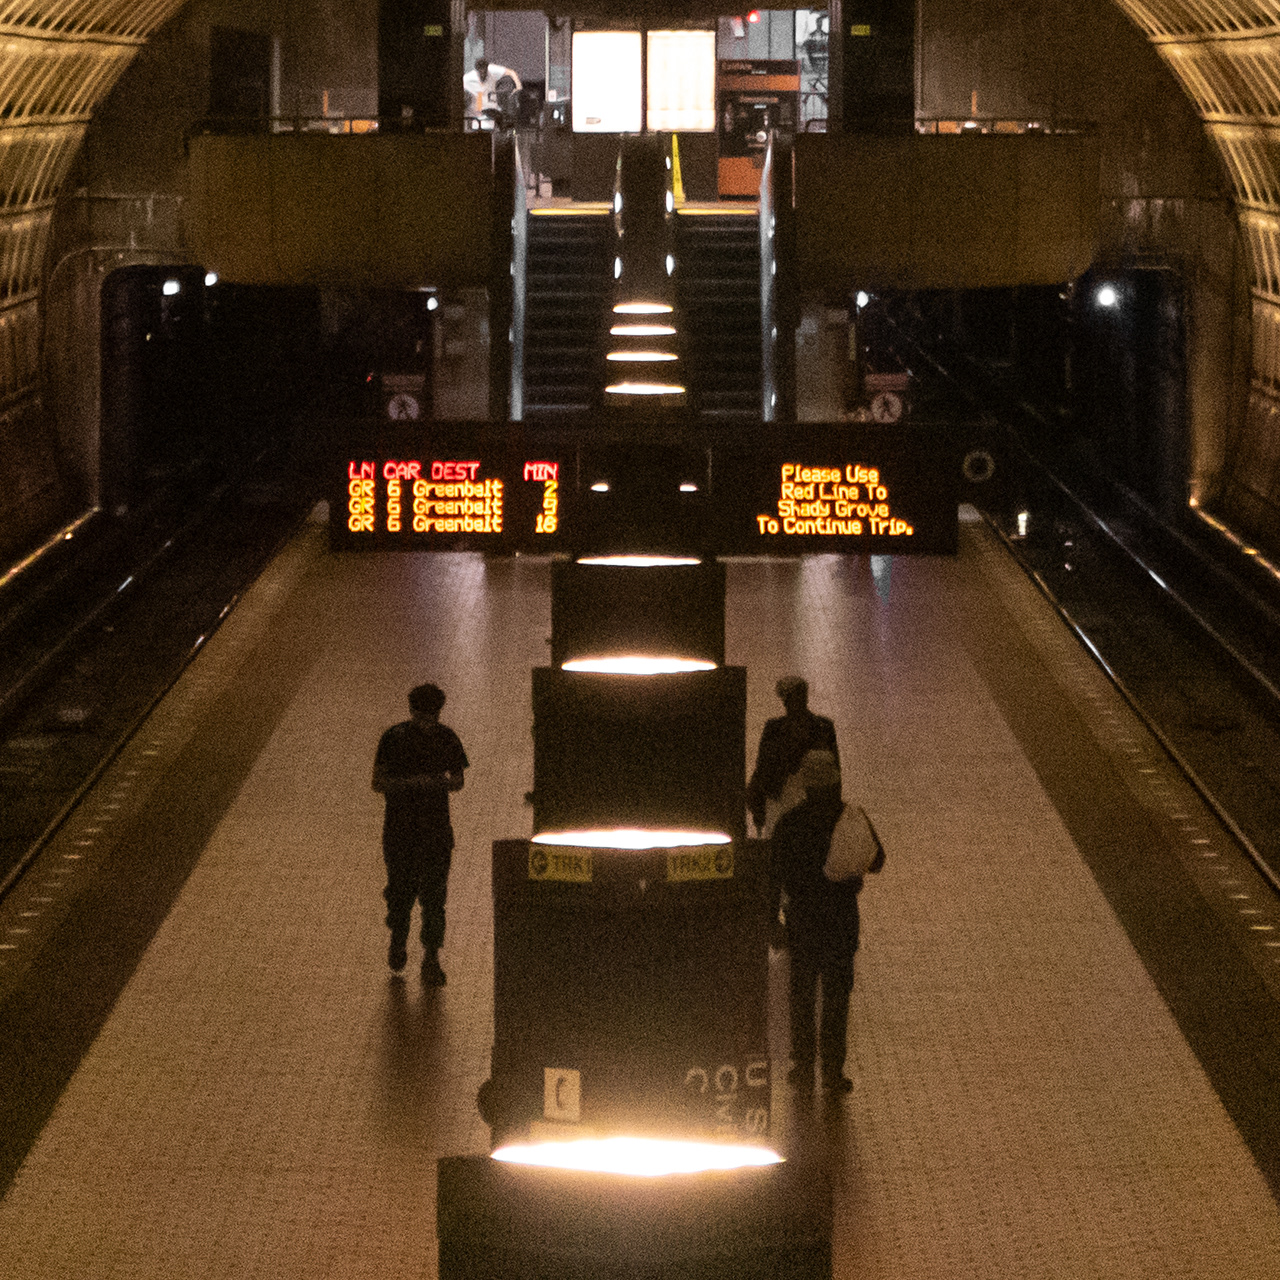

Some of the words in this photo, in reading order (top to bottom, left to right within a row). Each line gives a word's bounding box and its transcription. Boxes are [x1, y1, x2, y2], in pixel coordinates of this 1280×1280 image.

[348, 461, 376, 479] LN
[383, 460, 421, 480] CAR
[431, 461, 480, 480] DEST
[523, 461, 559, 481] MIN
[781, 464, 842, 483] Please
[845, 464, 880, 483] Use
[348, 479, 376, 497] GR
[386, 479, 401, 497] 6
[413, 479, 504, 497] Greenbelt
[543, 480, 559, 497] 2
[781, 483, 815, 500] Red
[819, 483, 859, 500] Line
[865, 483, 888, 500] To
[348, 497, 376, 514] GR
[386, 497, 402, 514] 6
[413, 497, 504, 514] Greenbelt
[542, 497, 559, 515] 9
[778, 500, 831, 518] Shady
[835, 501, 889, 518] Grove
[348, 514, 376, 532] GR
[386, 514, 402, 532] 6
[412, 514, 503, 533] Greenbelt
[757, 515, 779, 534] To
[782, 517, 862, 535] Continue
